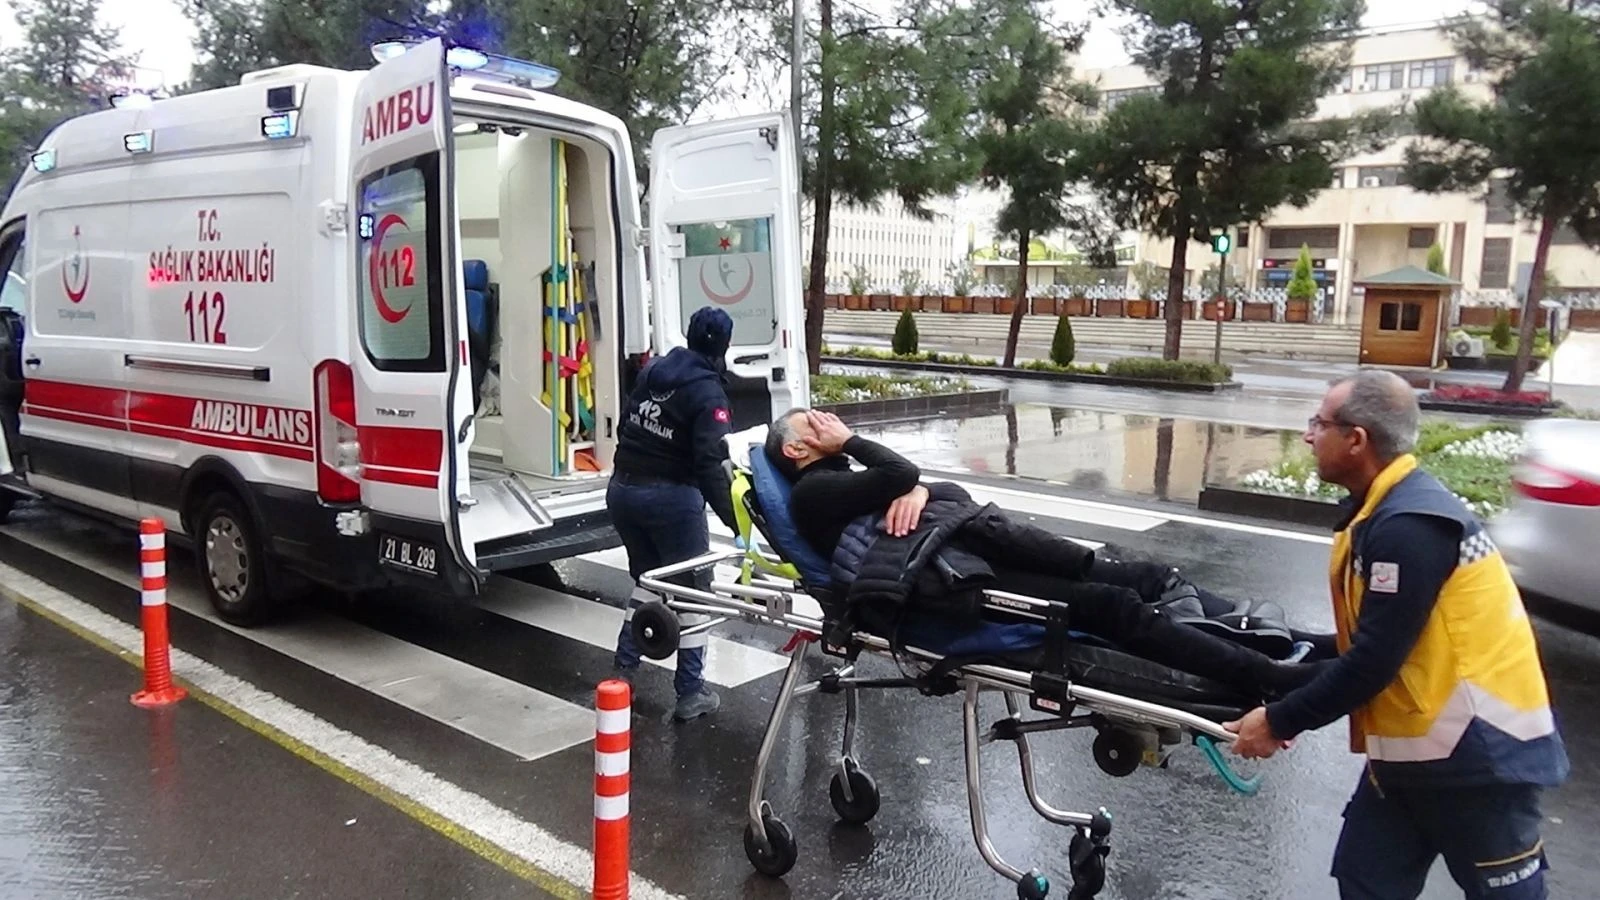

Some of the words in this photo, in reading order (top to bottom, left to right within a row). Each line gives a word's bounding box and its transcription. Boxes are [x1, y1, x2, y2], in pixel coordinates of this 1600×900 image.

[362, 82, 435, 146] AMBU
[198, 210, 221, 242] T.C.
[149, 245, 193, 282] SAĞLIK
[199, 242, 275, 283] BAKANLIĞI
[380, 247, 415, 288] 112
[184, 291, 226, 344] 112
[191, 400, 310, 444] AMBULANS
[385, 538, 396, 559] 21
[401, 542, 413, 565] BL
[416, 545, 436, 570] 289
